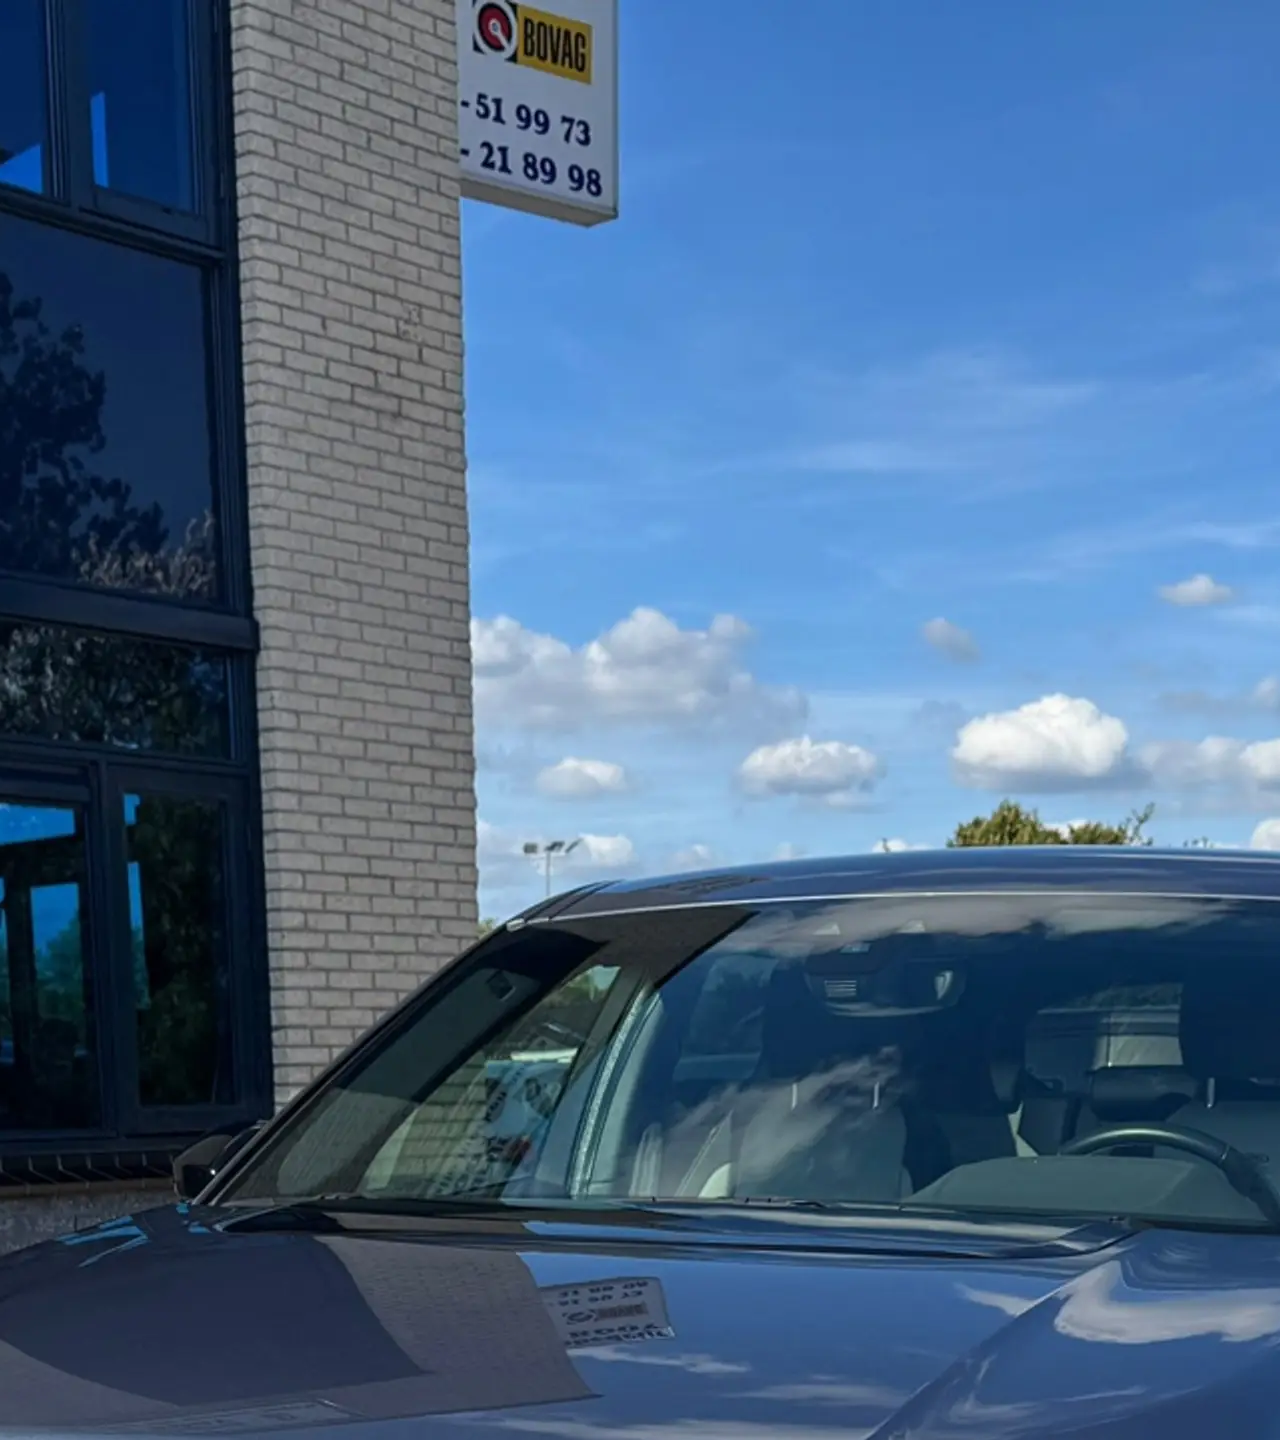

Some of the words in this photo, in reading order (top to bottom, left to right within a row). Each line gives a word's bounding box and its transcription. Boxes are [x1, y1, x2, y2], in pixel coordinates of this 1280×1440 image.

[523, 17, 587, 73] BOVAG
[515, 104, 550, 135] 99
[560, 115, 591, 146] 73
[480, 141, 512, 174] 21
[523, 152, 557, 184] 89
[568, 164, 602, 197] 98
